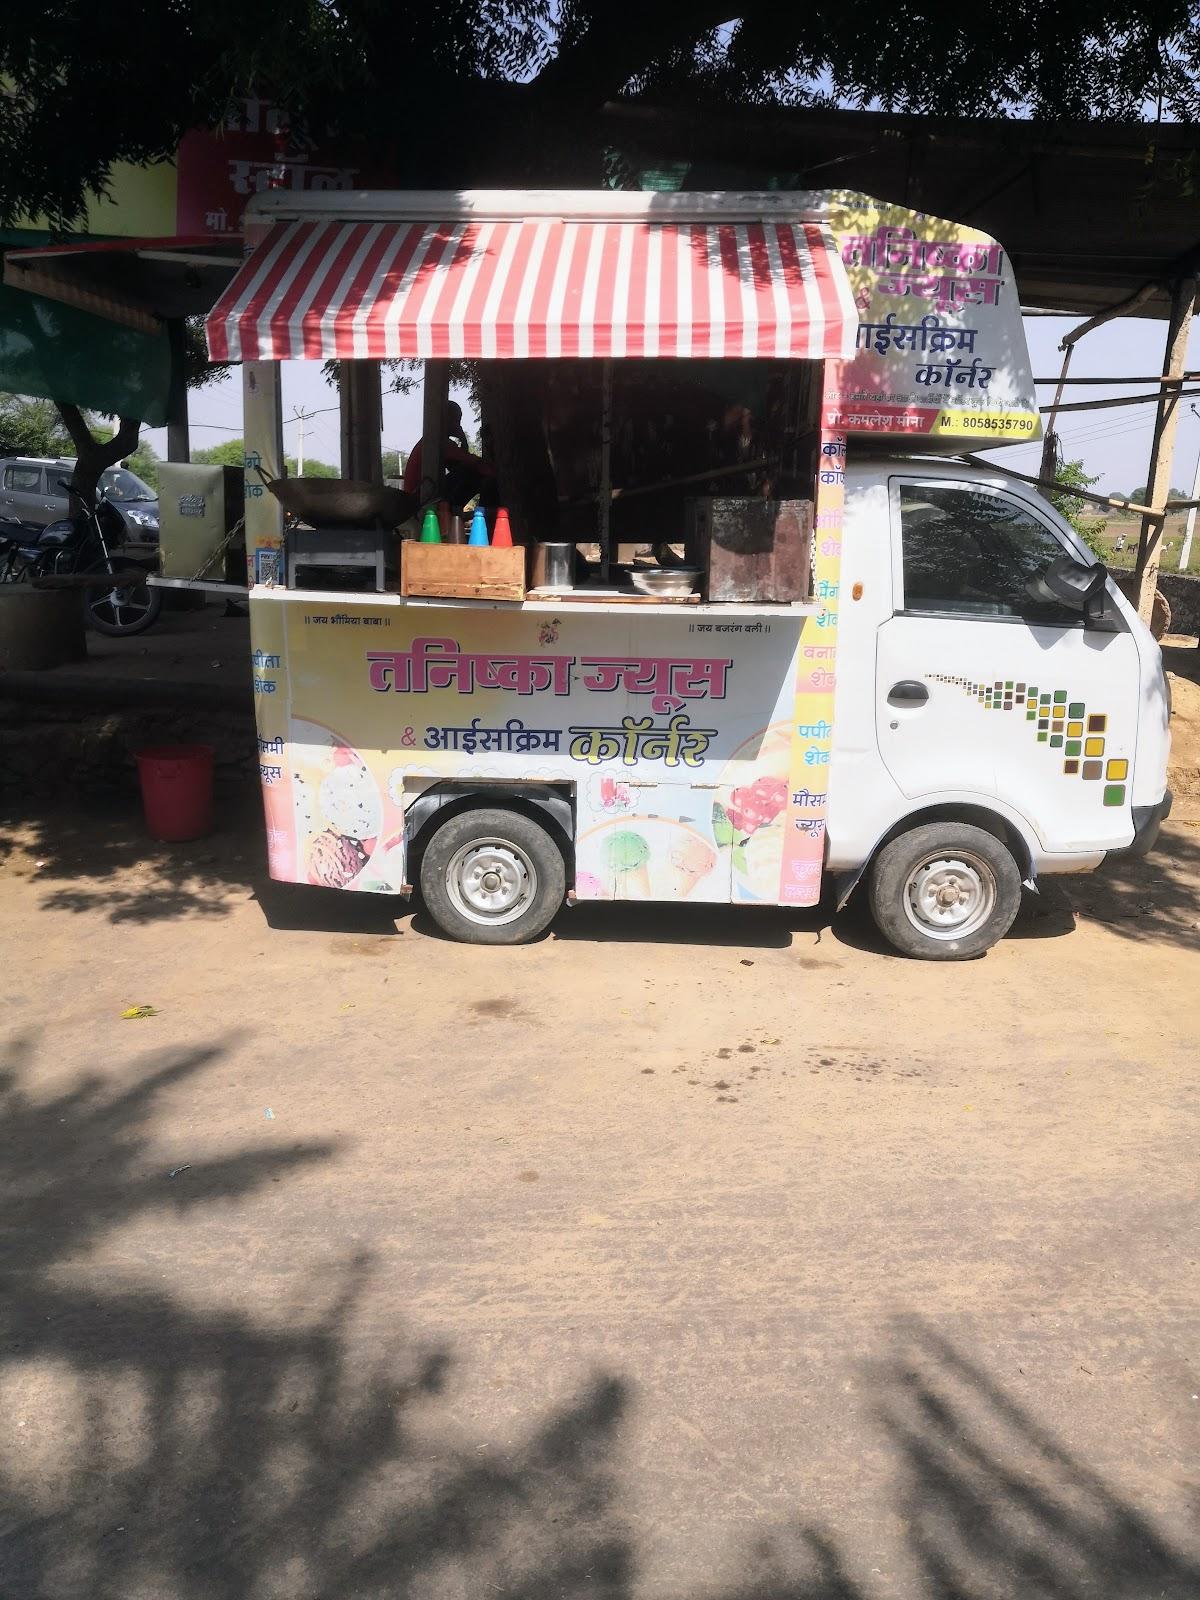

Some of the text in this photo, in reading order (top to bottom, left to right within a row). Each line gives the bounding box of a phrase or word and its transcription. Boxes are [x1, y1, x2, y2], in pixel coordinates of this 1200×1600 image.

[841, 226, 1005, 276] तनिष्का
[855, 286, 871, 310] &
[875, 272, 1005, 314] ज्यूस
[915, 358, 997, 389] कॉर्नर
[848, 410, 894, 427] कमलेश
[896, 411, 925, 428] मीना
[963, 417, 1033, 431] 8058535790
[313, 616, 328, 624] जय
[363, 617, 382, 625] बाबा
[697, 624, 713, 632] जय
[367, 637, 733, 715] तनिष्का ज्यूस
[401, 714, 718, 767] & आईसक्रिम कॉर्नर
